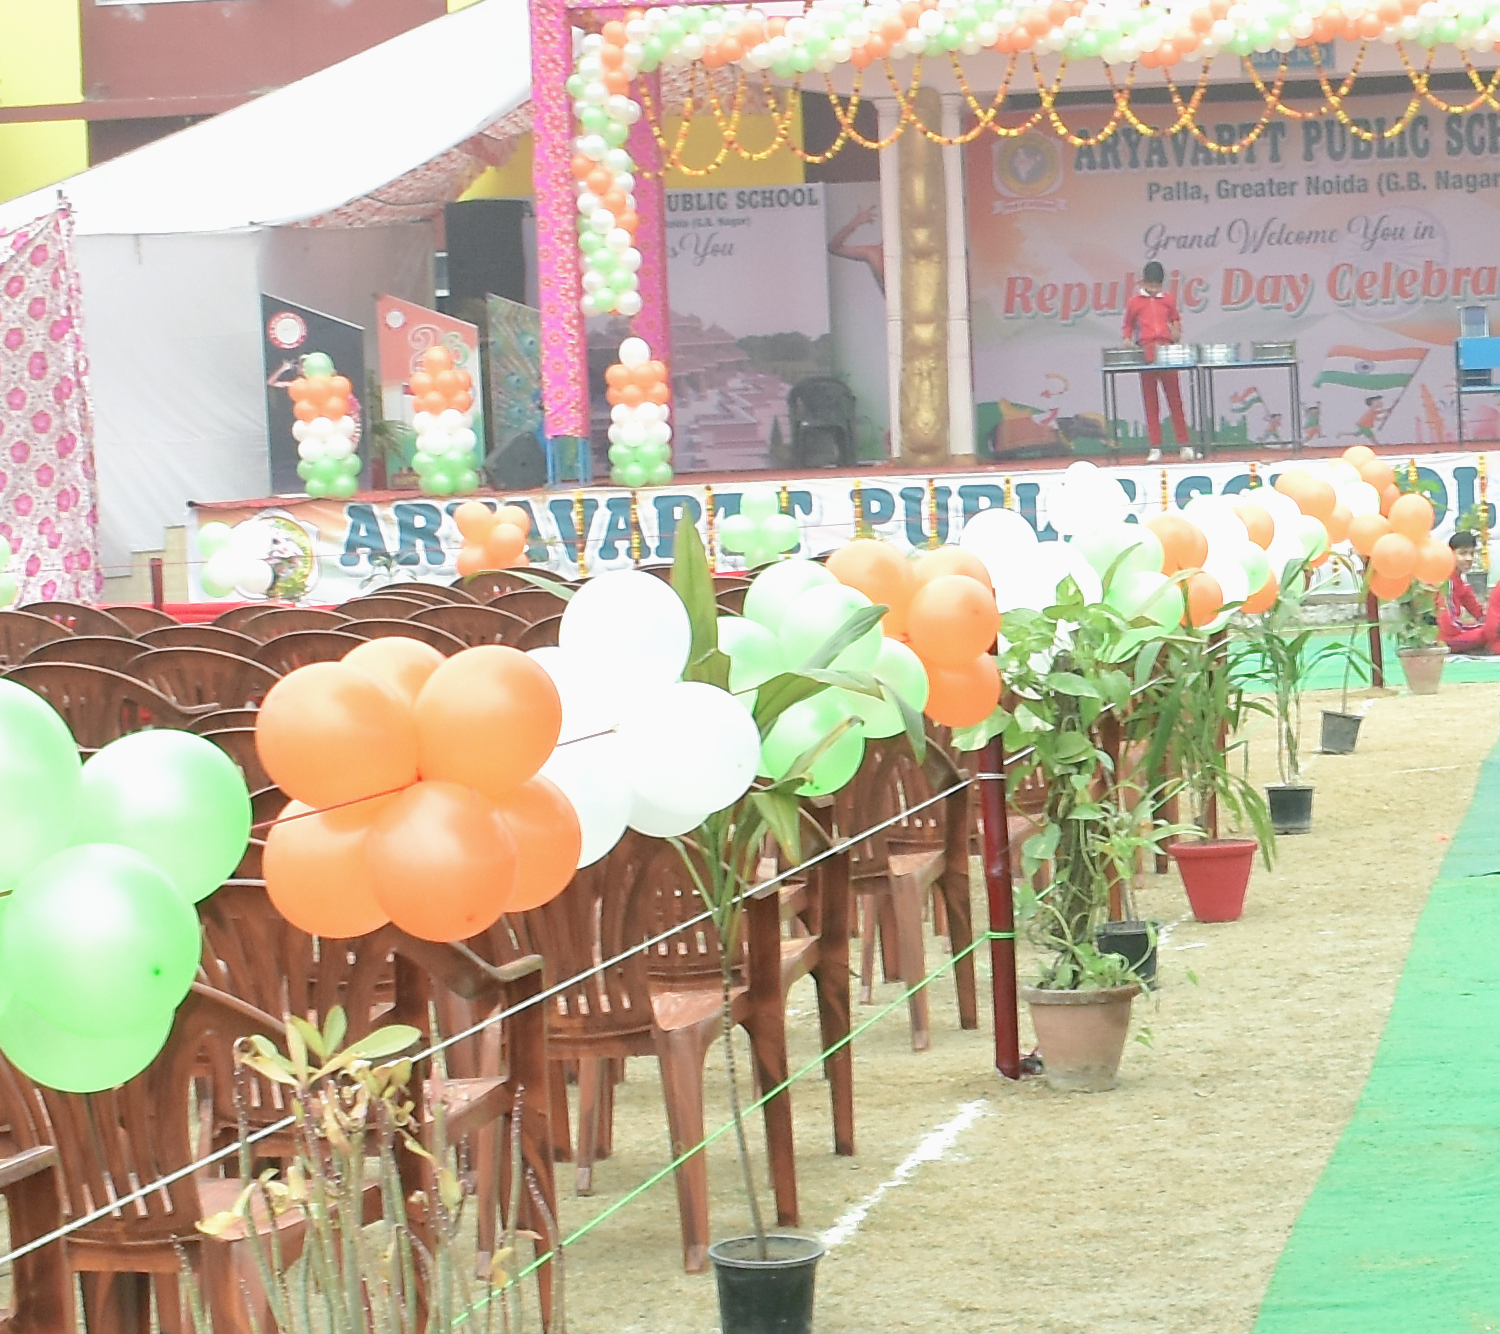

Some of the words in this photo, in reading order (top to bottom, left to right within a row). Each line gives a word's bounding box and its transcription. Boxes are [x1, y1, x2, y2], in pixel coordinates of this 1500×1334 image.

[1074, 119, 1286, 172] ARYAVARTT
[1302, 114, 1431, 162] PUBLIC
[666, 191, 728, 213] UBLIC
[735, 187, 819, 210] SCHOOL
[1147, 182, 1210, 203] Palla,
[1217, 178, 1298, 200] Greater
[1305, 174, 1369, 196] Noida
[1377, 171, 1428, 197] (G.B.
[1142, 222, 1220, 260] Grand
[1226, 217, 1338, 255] Welcome
[1346, 214, 1406, 252] You
[1414, 220, 1436, 241] in
[1004, 268, 1207, 323] Repuic
[1220, 267, 1312, 317] Day
